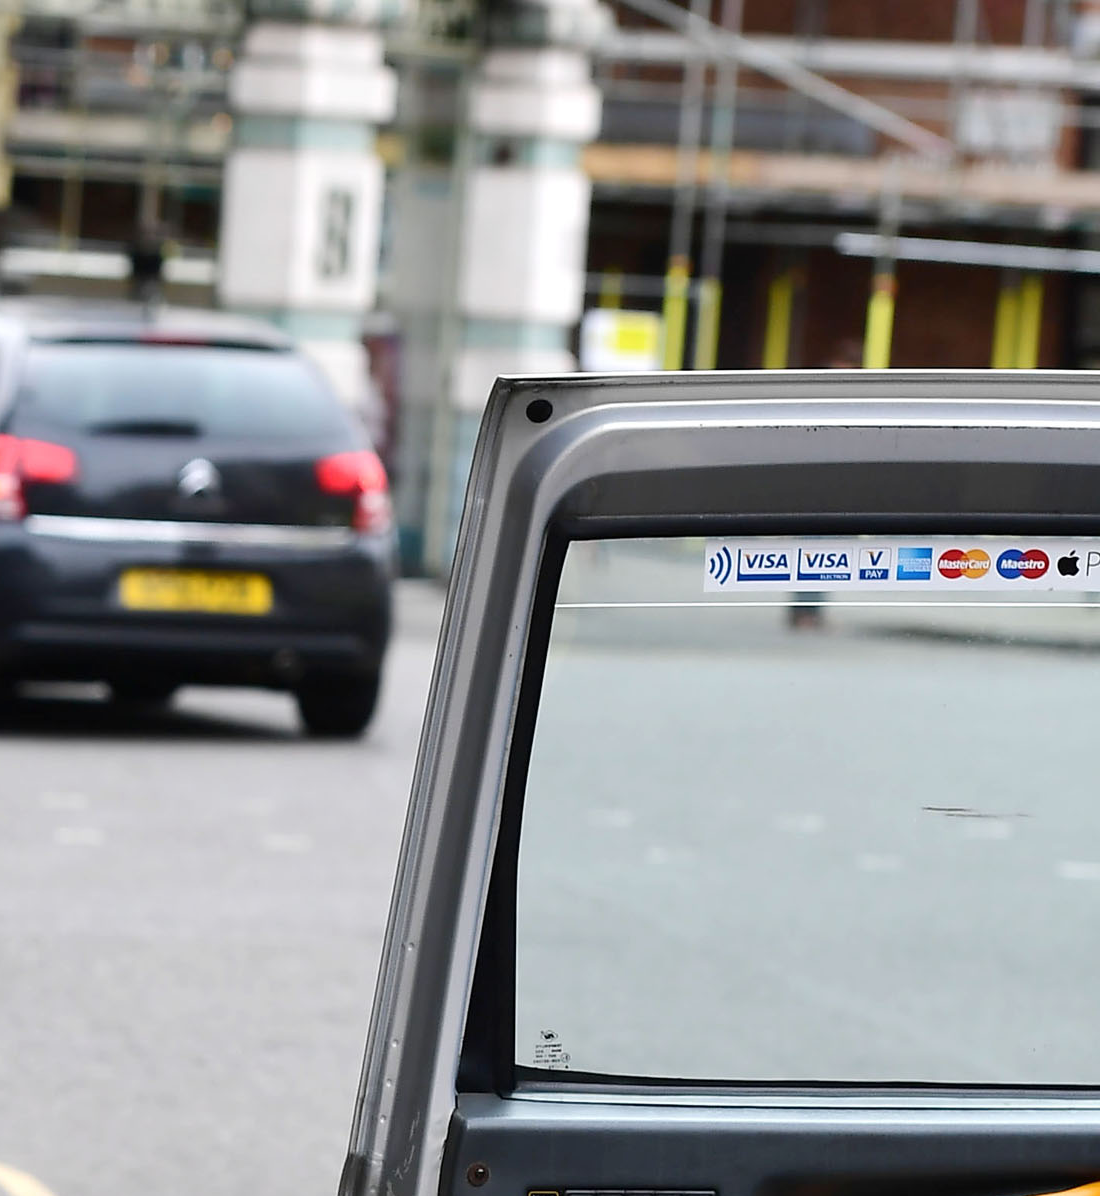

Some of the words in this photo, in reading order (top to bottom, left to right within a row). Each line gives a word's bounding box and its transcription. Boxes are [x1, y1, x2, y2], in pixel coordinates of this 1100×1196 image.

[745, 553, 788, 569] VISA
[804, 553, 849, 568] VISA
[867, 551, 883, 566] V
[939, 560, 990, 570] MasterCard
[1001, 559, 1046, 570] Maestro
[865, 570, 883, 579] PAY
